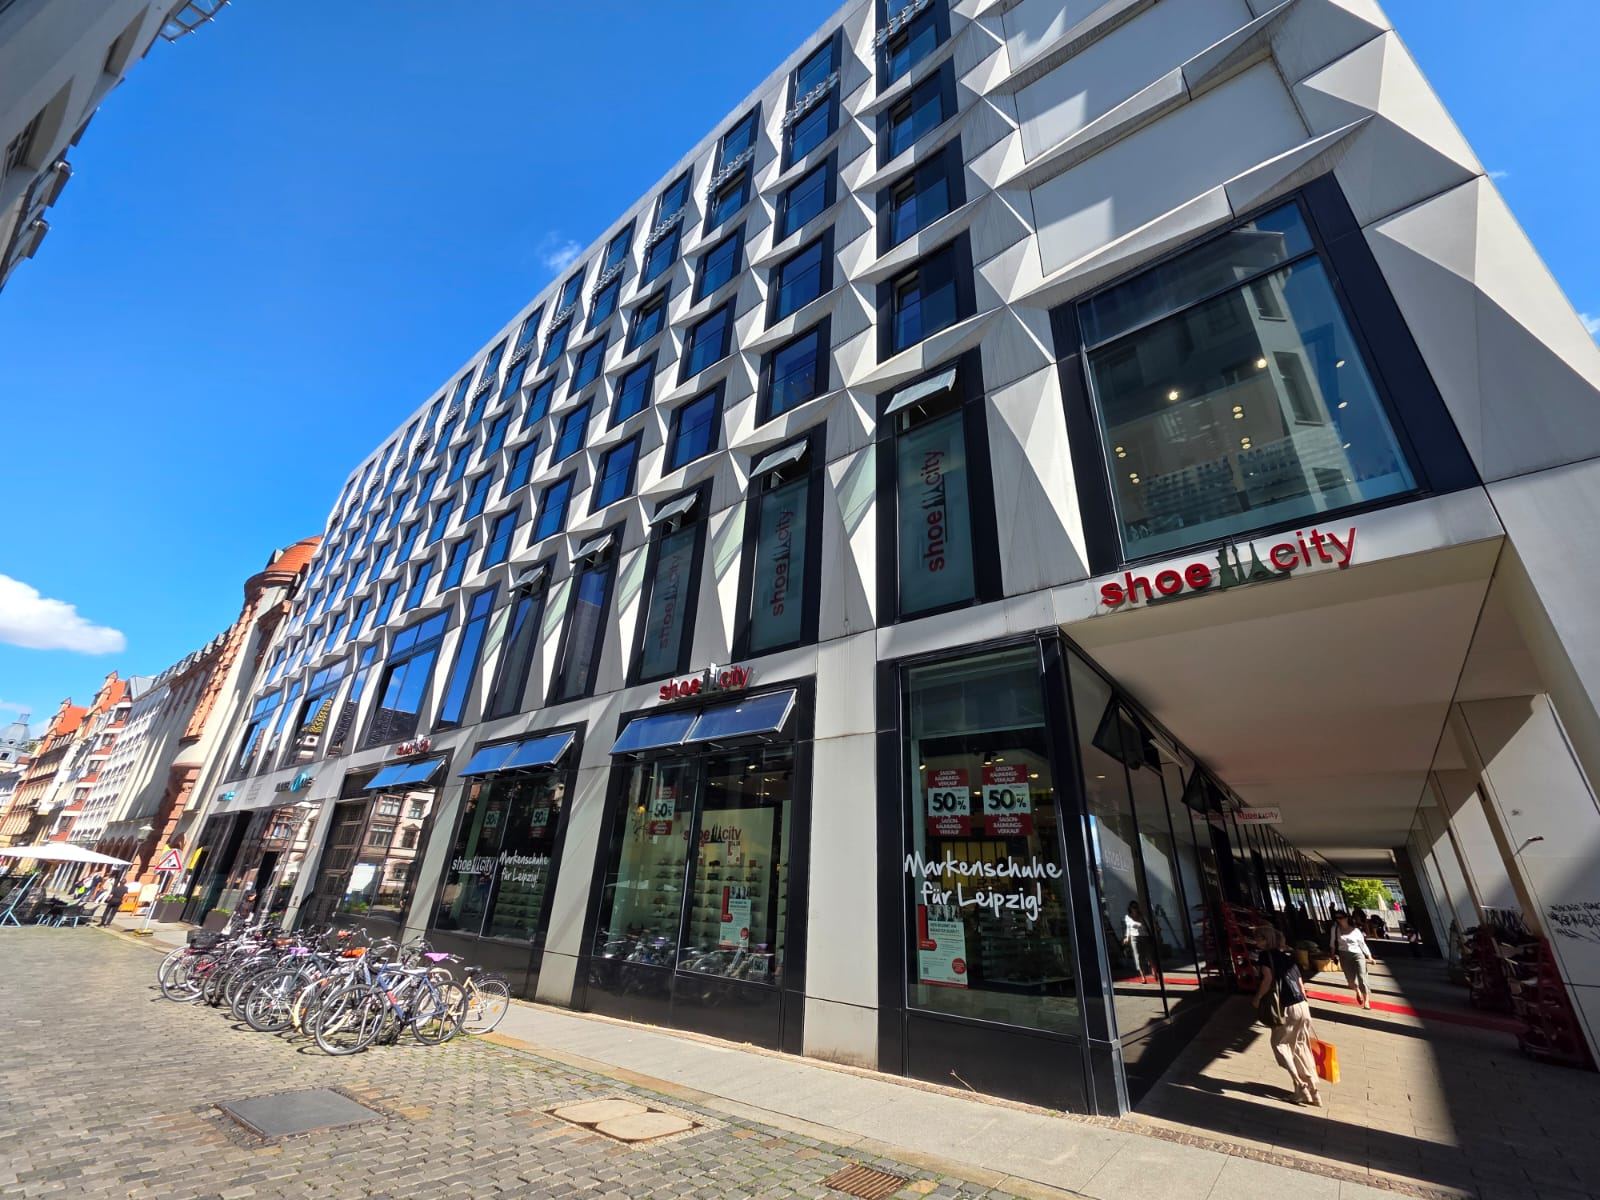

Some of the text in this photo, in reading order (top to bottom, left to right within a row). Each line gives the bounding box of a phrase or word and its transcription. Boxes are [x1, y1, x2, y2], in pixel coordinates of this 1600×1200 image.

[921, 450, 945, 573] shoe city
[771, 510, 794, 617] shoe city
[1100, 527, 1357, 608] shoe city
[659, 665, 753, 701] shoe city
[932, 792, 966, 811] 50%
[988, 789, 1026, 810] 50%
[722, 826, 742, 841] city
[451, 855, 494, 872] shoe city
[500, 849, 549, 866] Markenschuhe
[904, 851, 1062, 878] Markenschuhe
[920, 881, 1042, 922] für Leipzig!
